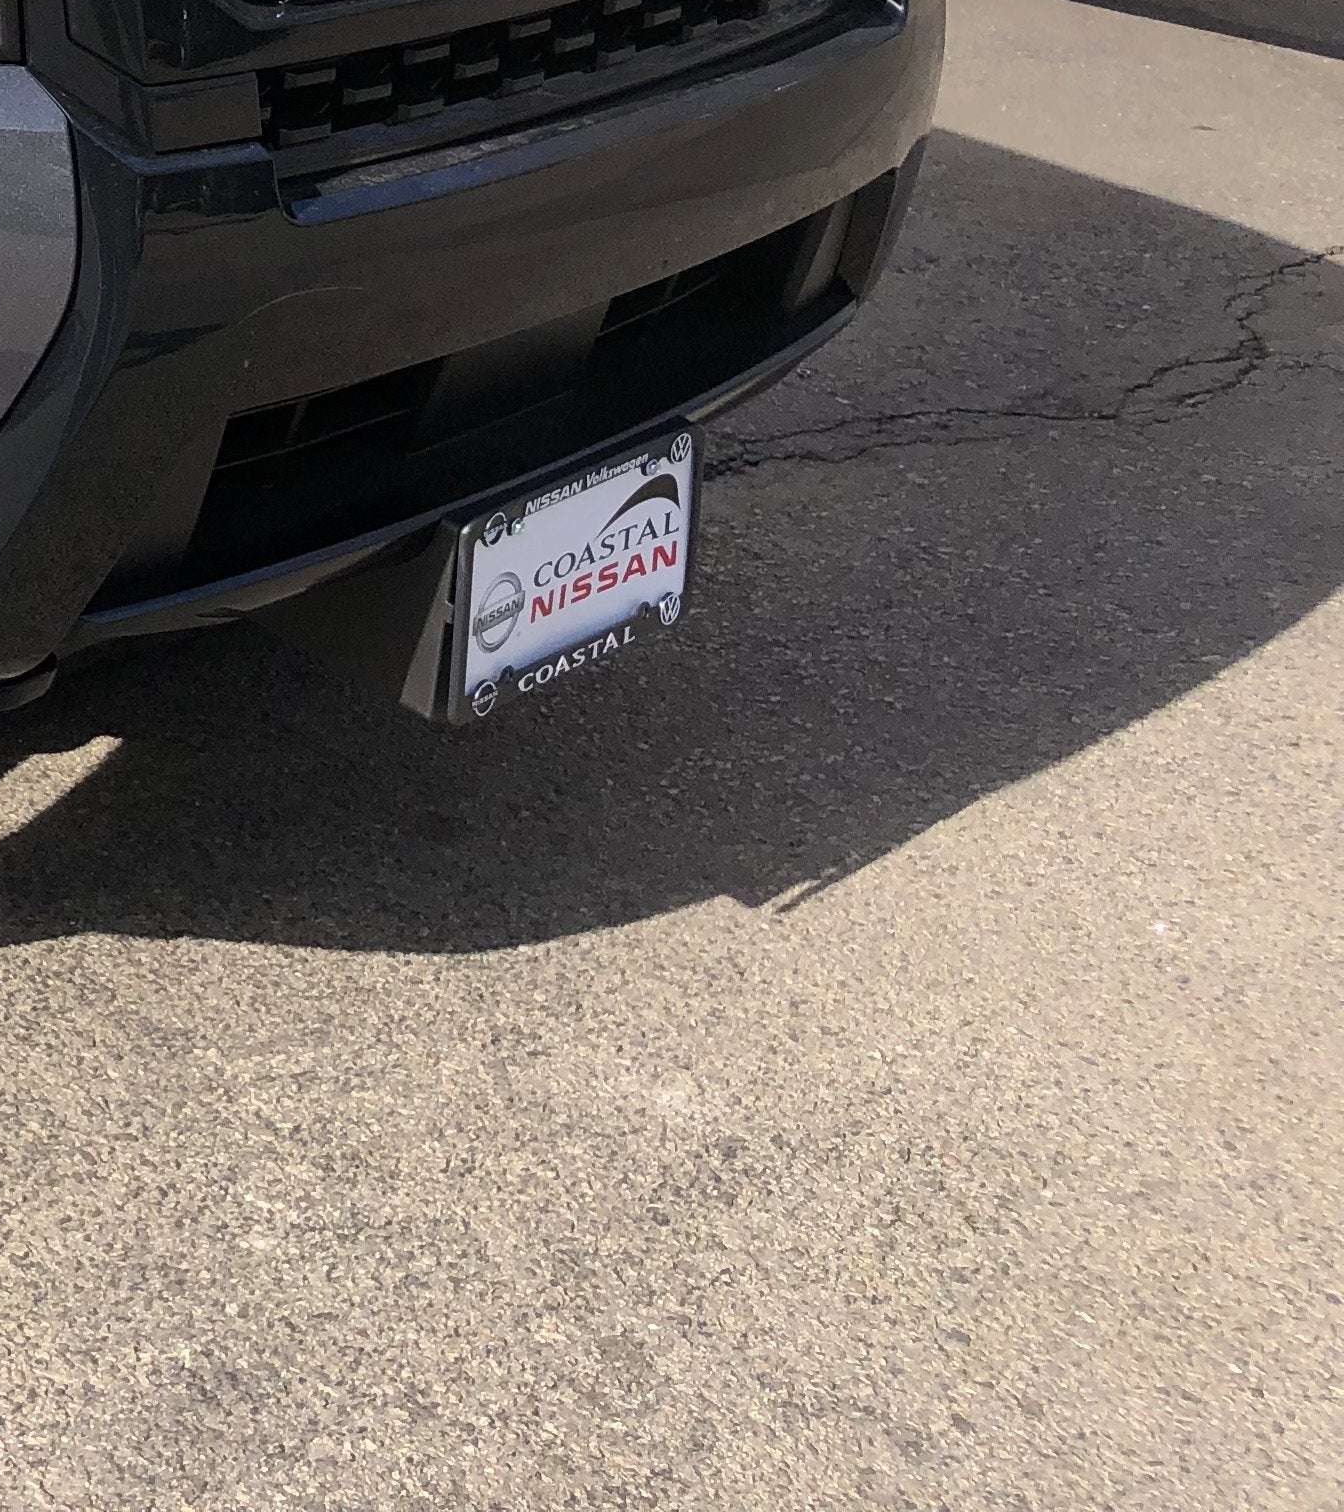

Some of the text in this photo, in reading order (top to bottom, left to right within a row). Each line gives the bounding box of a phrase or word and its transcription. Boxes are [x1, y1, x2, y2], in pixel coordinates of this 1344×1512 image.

[525, 453, 649, 516] NISSAN Volkswagen
[530, 540, 679, 624] NISSAN
[533, 510, 681, 588] COASTAL
[476, 596, 522, 630] NISSAN
[517, 626, 636, 693] COASTAL
